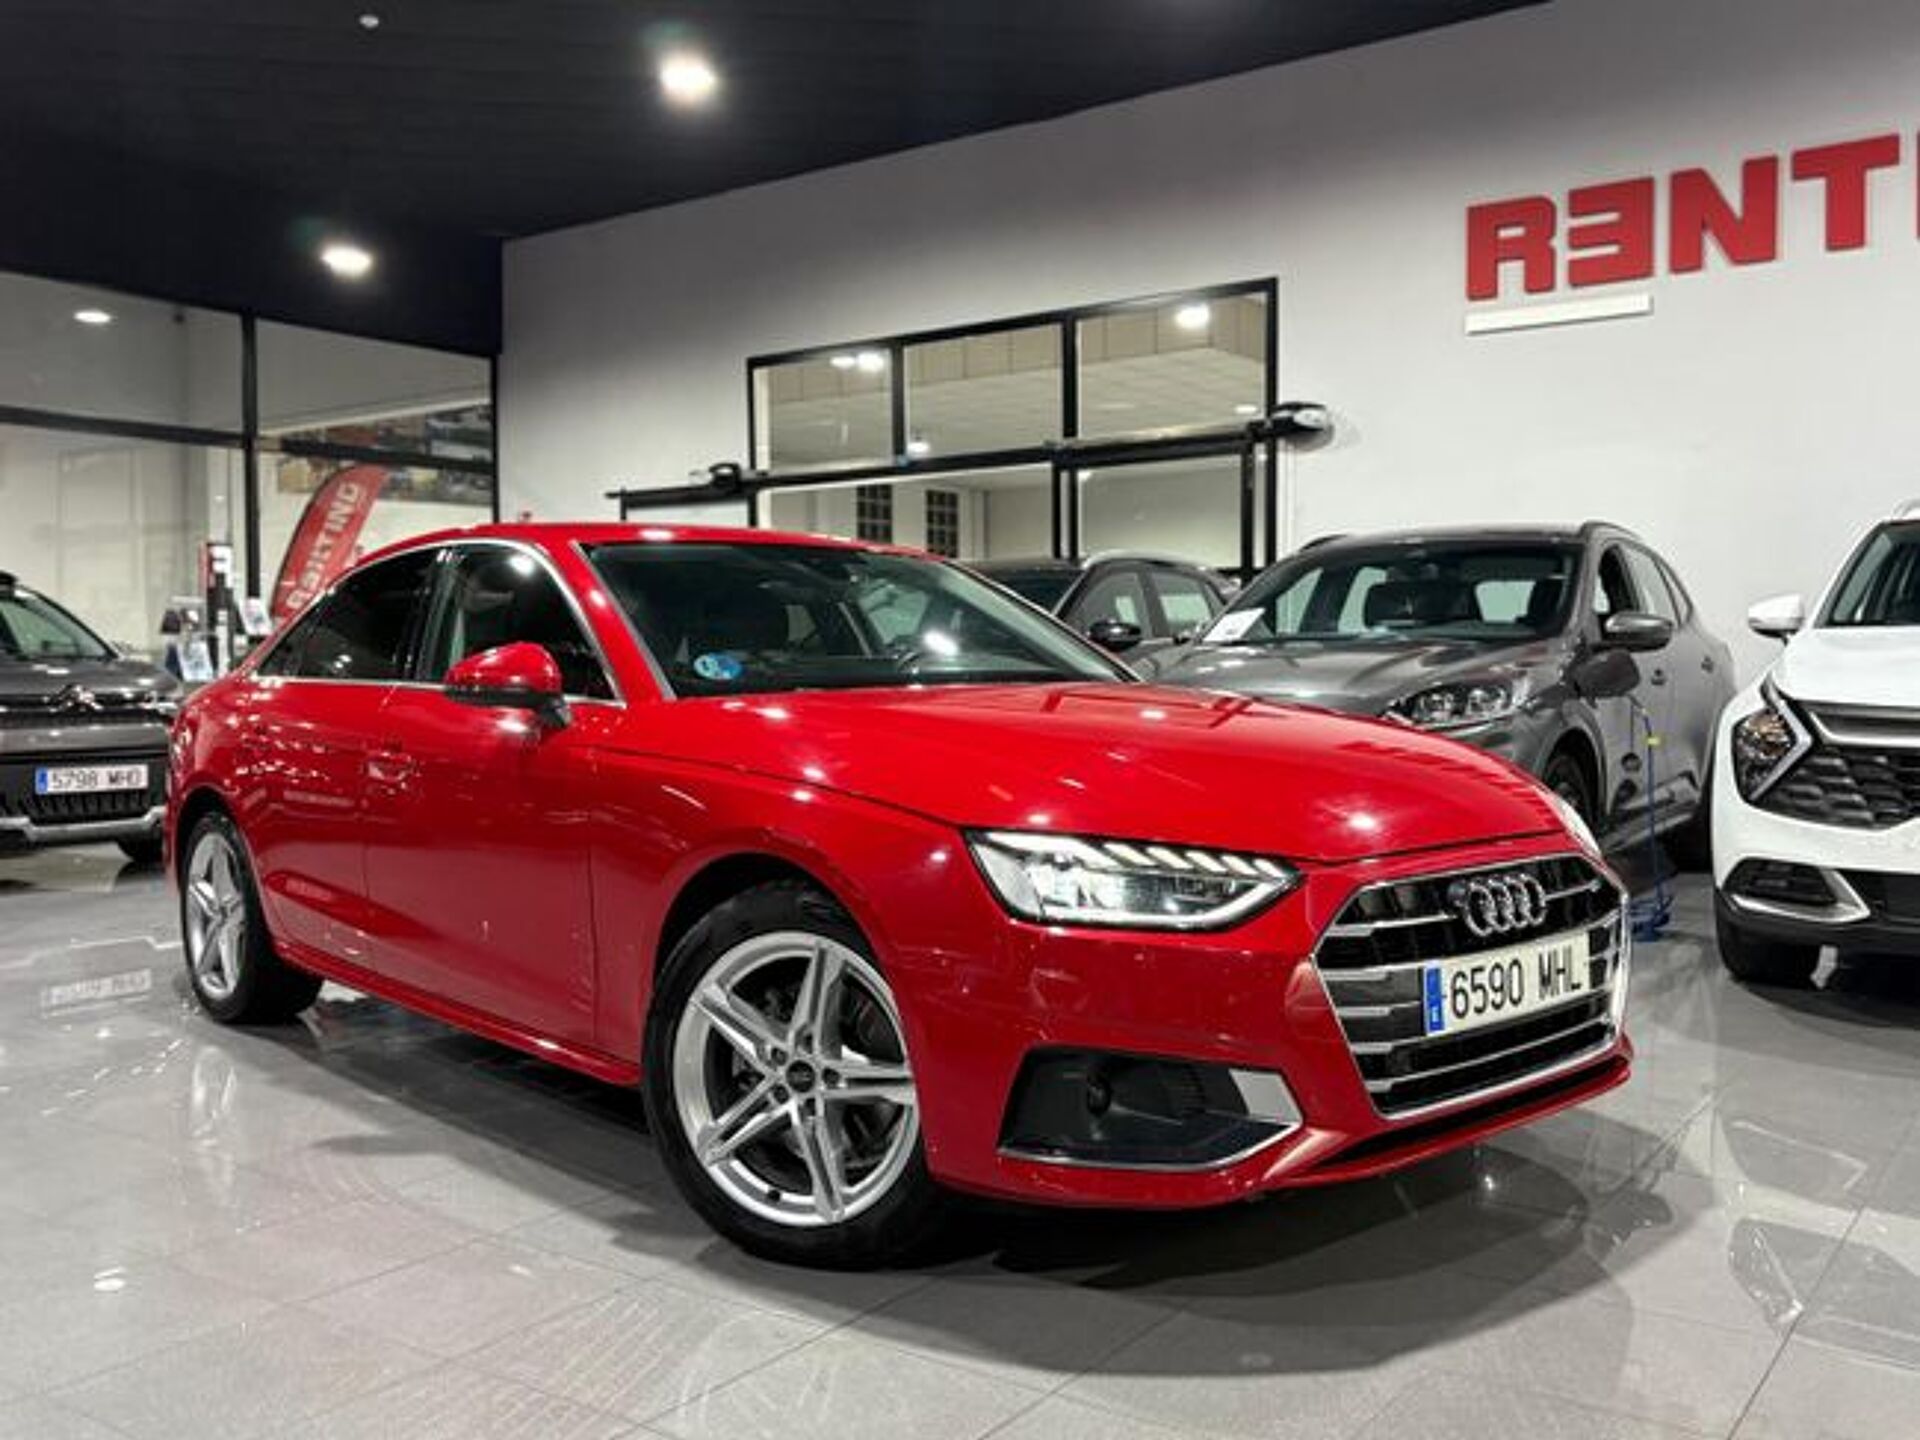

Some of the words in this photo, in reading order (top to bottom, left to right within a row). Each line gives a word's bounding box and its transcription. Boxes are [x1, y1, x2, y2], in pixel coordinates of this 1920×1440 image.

[1466, 131, 1920, 302] RENT
[52, 770, 98, 789] 5798
[1451, 957, 1525, 1020] 6590
[1538, 945, 1583, 1001] MHL
